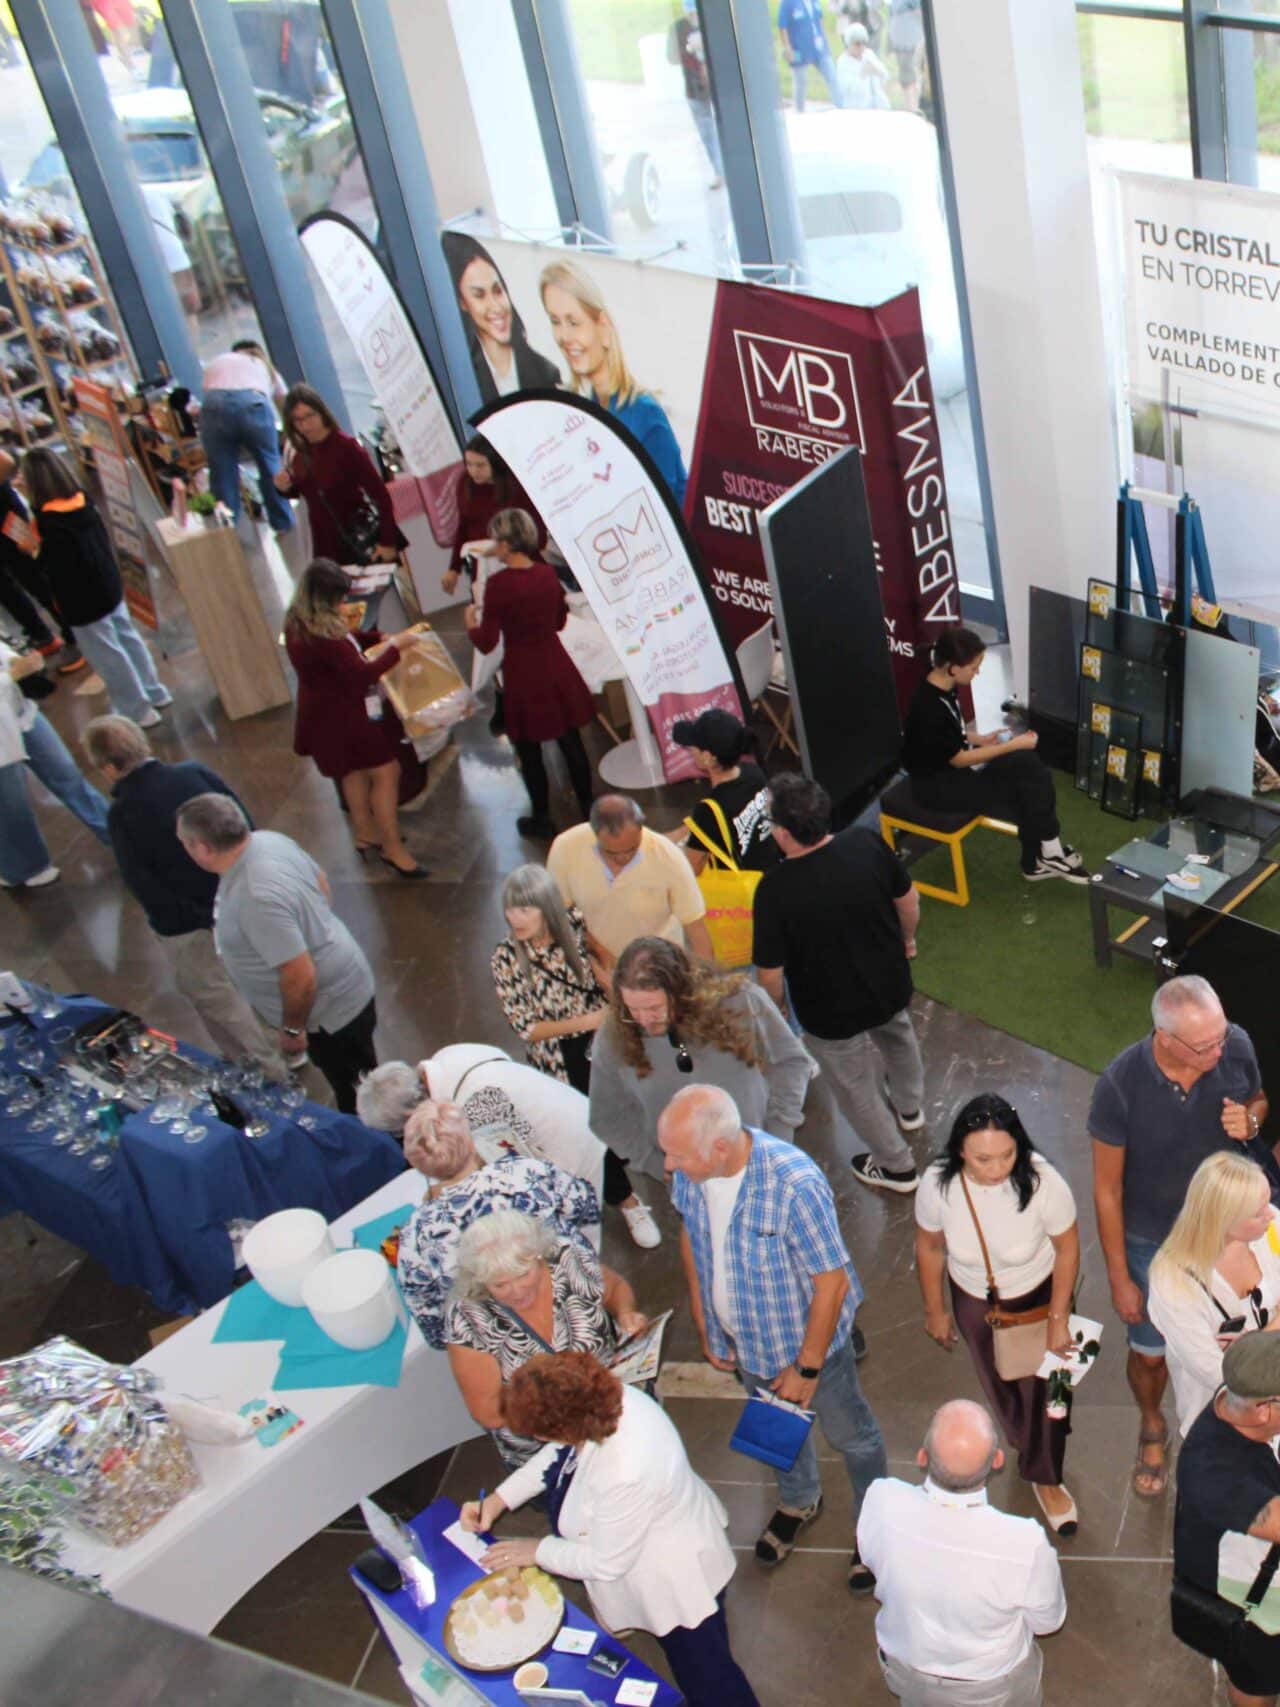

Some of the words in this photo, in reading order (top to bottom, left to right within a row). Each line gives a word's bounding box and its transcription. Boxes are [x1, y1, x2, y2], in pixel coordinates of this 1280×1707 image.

[1135, 219, 1168, 247] TU
[1142, 255, 1174, 282] EN
[1147, 343, 1236, 378] VALLADO
[1241, 364, 1266, 385] DE
[748, 340, 847, 428] MB
[756, 429, 834, 465] RABES
[722, 470, 793, 503] SUCCESS
[704, 495, 752, 535] BEST
[893, 366, 961, 665] ABESMA
[713, 567, 741, 589] WE
[744, 576, 773, 598] ARE
[711, 584, 729, 602] O
[887, 636, 915, 658] MS
